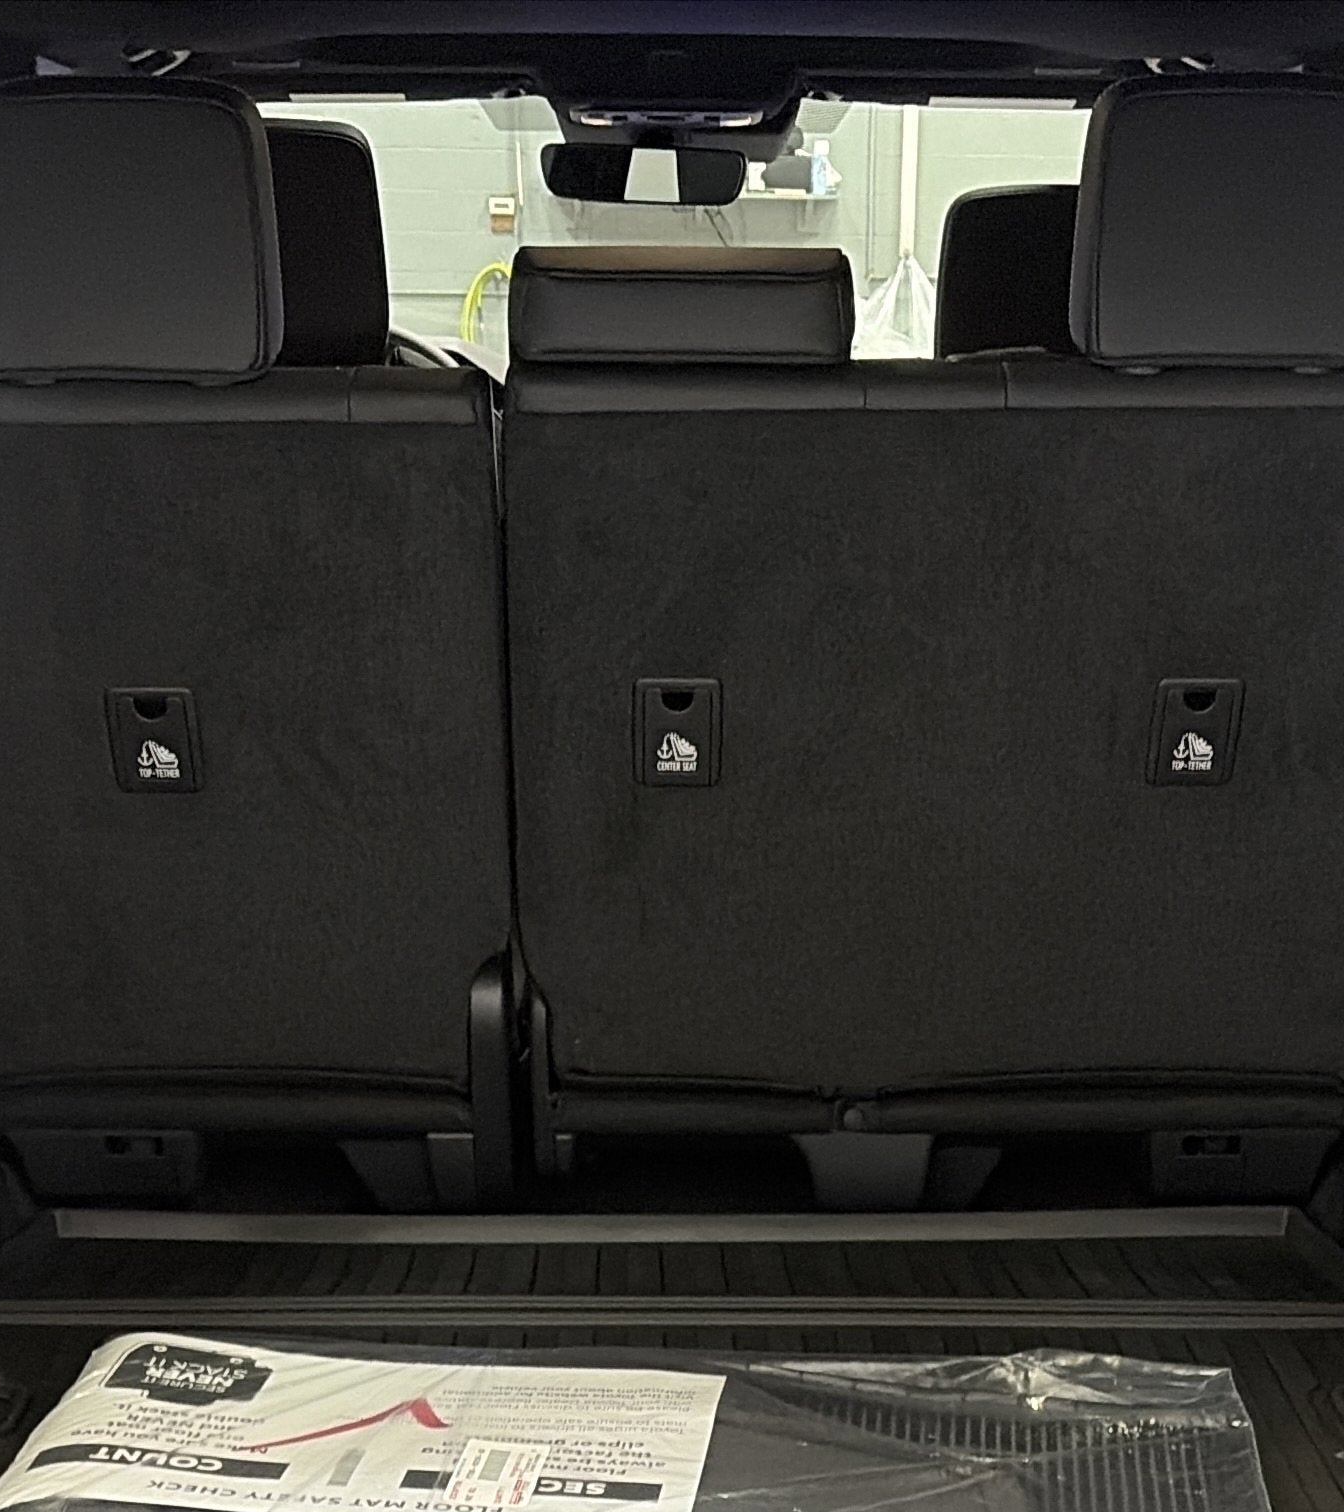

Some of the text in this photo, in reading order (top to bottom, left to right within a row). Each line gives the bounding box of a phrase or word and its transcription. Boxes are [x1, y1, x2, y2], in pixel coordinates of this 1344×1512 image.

[657, 761, 697, 772] CENTER SEAT
[142, 1355, 248, 1380] STACK IT
[145, 1367, 235, 1388] NEVER
[140, 1376, 226, 1394] SECURE IT
[138, 1406, 190, 1418] stack
[106, 1420, 147, 1431] mat
[125, 1413, 194, 1429] NEVER
[195, 1413, 266, 1427] double
[70, 1429, 119, 1438] have
[123, 1431, 160, 1441] you
[152, 1427, 201, 1439] floor
[165, 1438, 208, 1448] sure
[598, 1440, 644, 1450] clips
[88, 1446, 223, 1471] COUNT
[552, 1448, 652, 1459] the factor
[597, 1459, 666, 1469] always
[573, 1465, 626, 1476] Floor
[146, 1480, 236, 1497] CHECK
[244, 1490, 342, 1506] SAFETY
[348, 1498, 405, 1510] MAT
